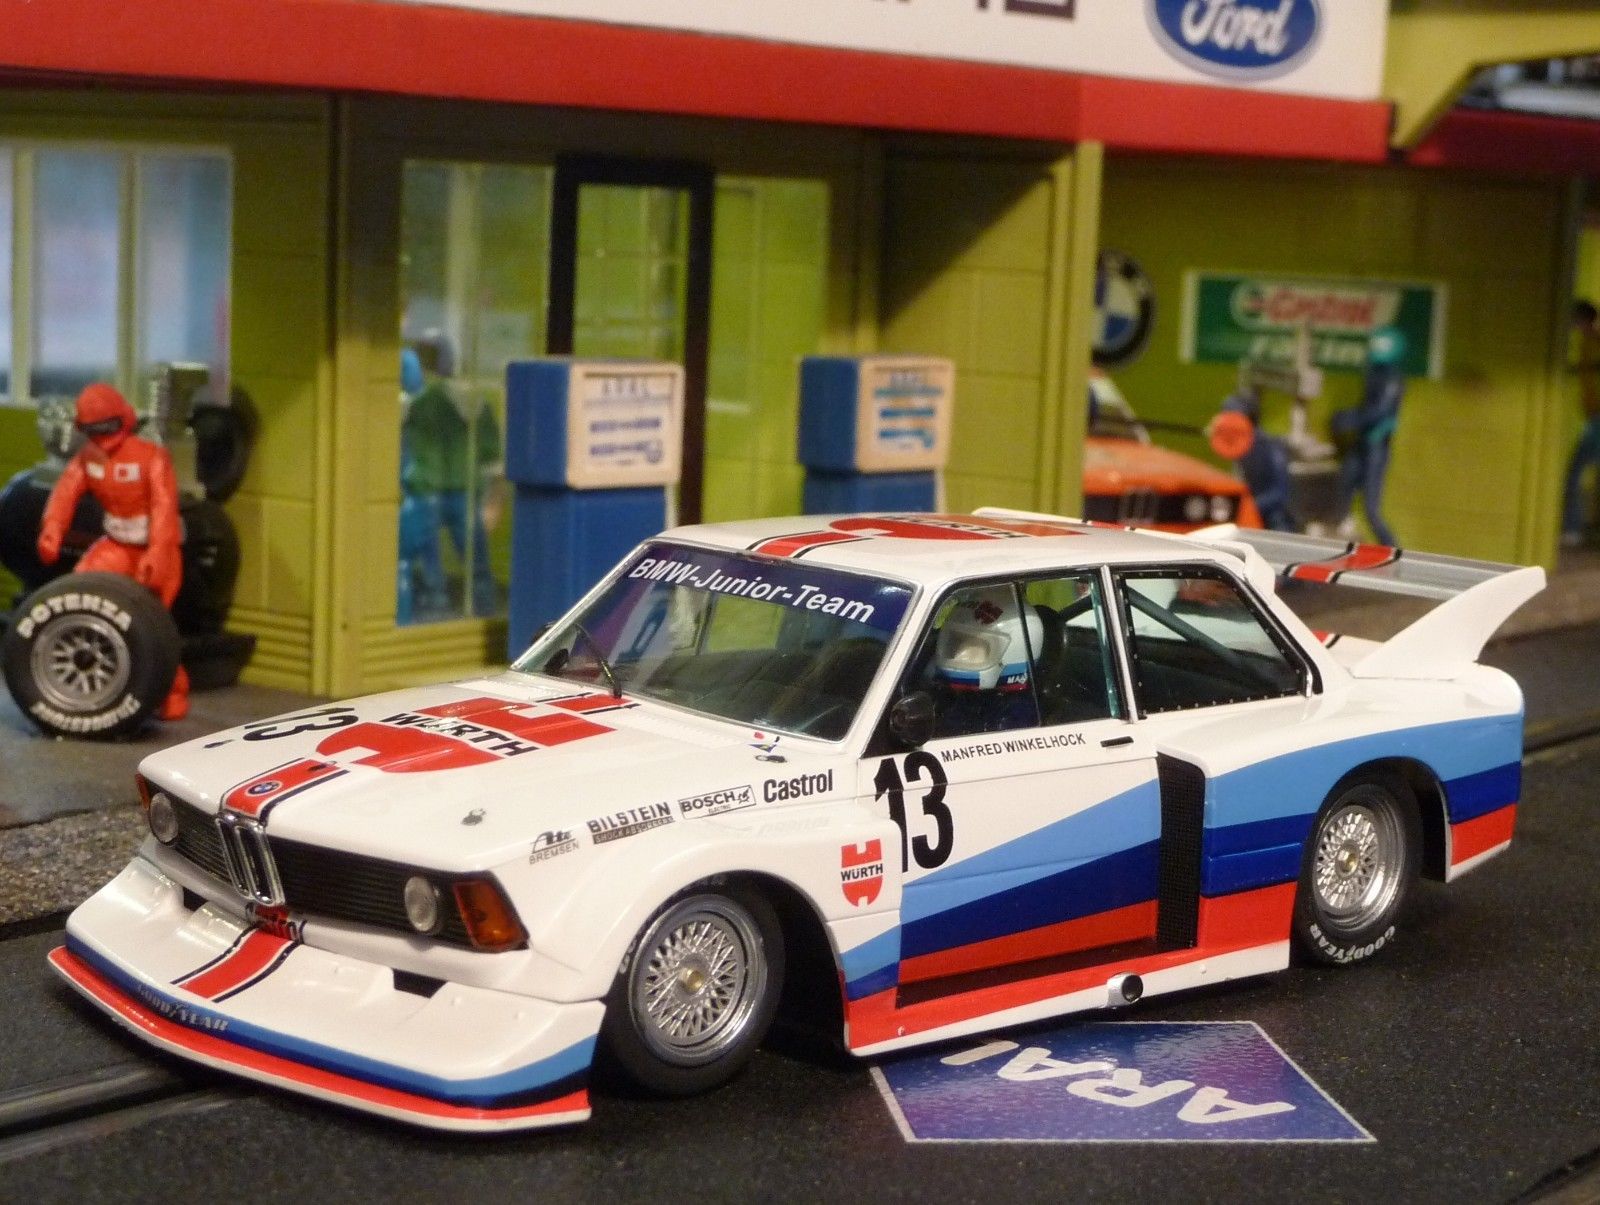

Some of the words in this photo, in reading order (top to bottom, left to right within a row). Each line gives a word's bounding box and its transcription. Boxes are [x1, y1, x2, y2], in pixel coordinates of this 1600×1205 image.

[629, 558, 876, 623] BMW-Junior-Team
[16, 593, 132, 639] POTENZA
[242, 707, 359, 741] 13
[941, 743, 1001, 762] MANFRED
[1003, 733, 1086, 753] WINKELHOCK
[680, 791, 736, 813] BOSCH
[763, 769, 833, 803] Castrol
[586, 802, 671, 833] BILSTEIN
[874, 750, 954, 873] 13
[594, 828, 624, 843] SHOCK
[529, 840, 580, 865] BREMSEN
[840, 863, 884, 881] WÜRTH
[1309, 923, 1396, 964] GOODYEAR
